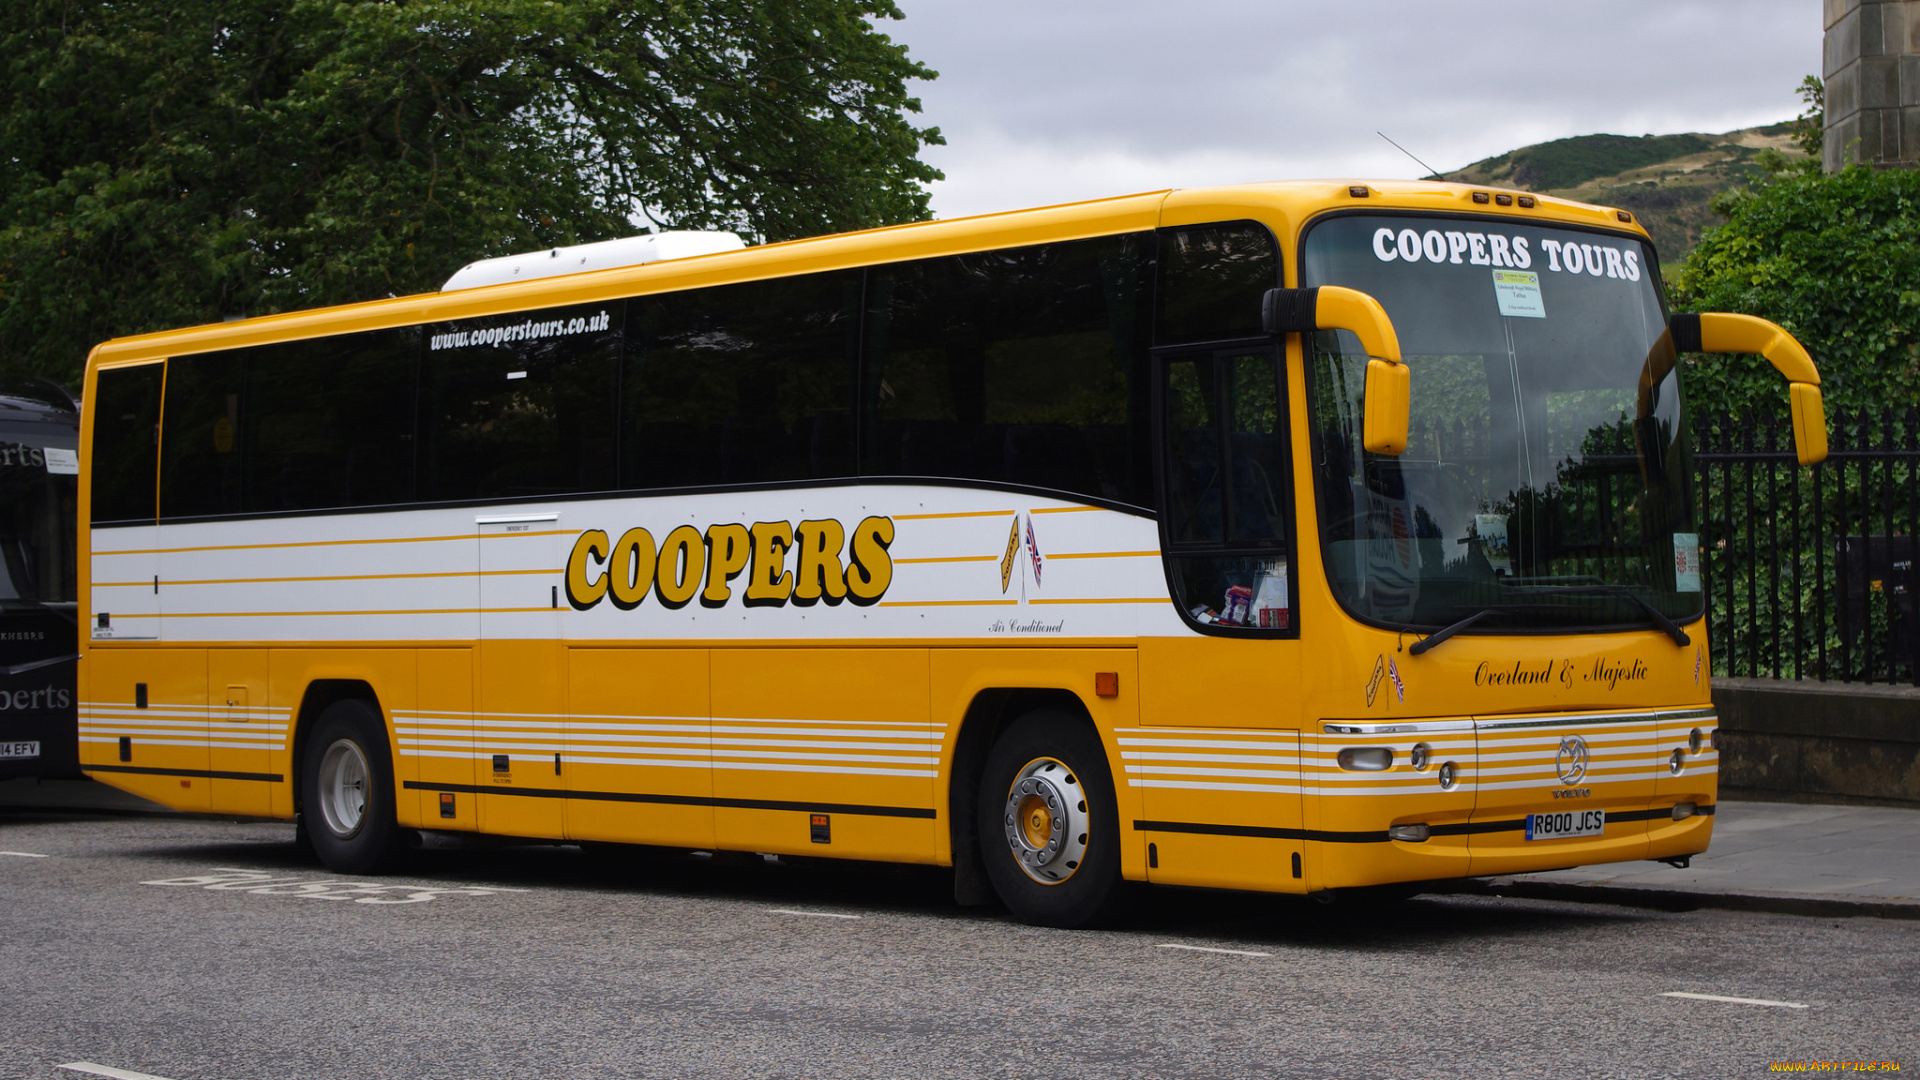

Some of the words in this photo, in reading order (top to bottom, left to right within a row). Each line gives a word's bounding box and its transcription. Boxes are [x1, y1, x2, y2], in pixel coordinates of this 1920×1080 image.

[1372, 227, 1531, 269] COOPERS
[1540, 238, 1641, 282] TOURS
[431, 310, 610, 351] www.cooperstours.co.uk
[0, 442, 44, 467] rts
[565, 515, 895, 611] COOPERS
[988, 619, 1005, 633] Air
[1009, 618, 1065, 633] Conditioned
[1474, 658, 1554, 687] Overland
[1559, 658, 1575, 689] &
[1583, 657, 1649, 691] Majestic
[15, 743, 36, 755] EFV
[1552, 787, 1591, 799] VOLVO
[1534, 813, 1572, 834] R800
[1576, 810, 1602, 831] JCS
[139, 873, 498, 904] BUSES
